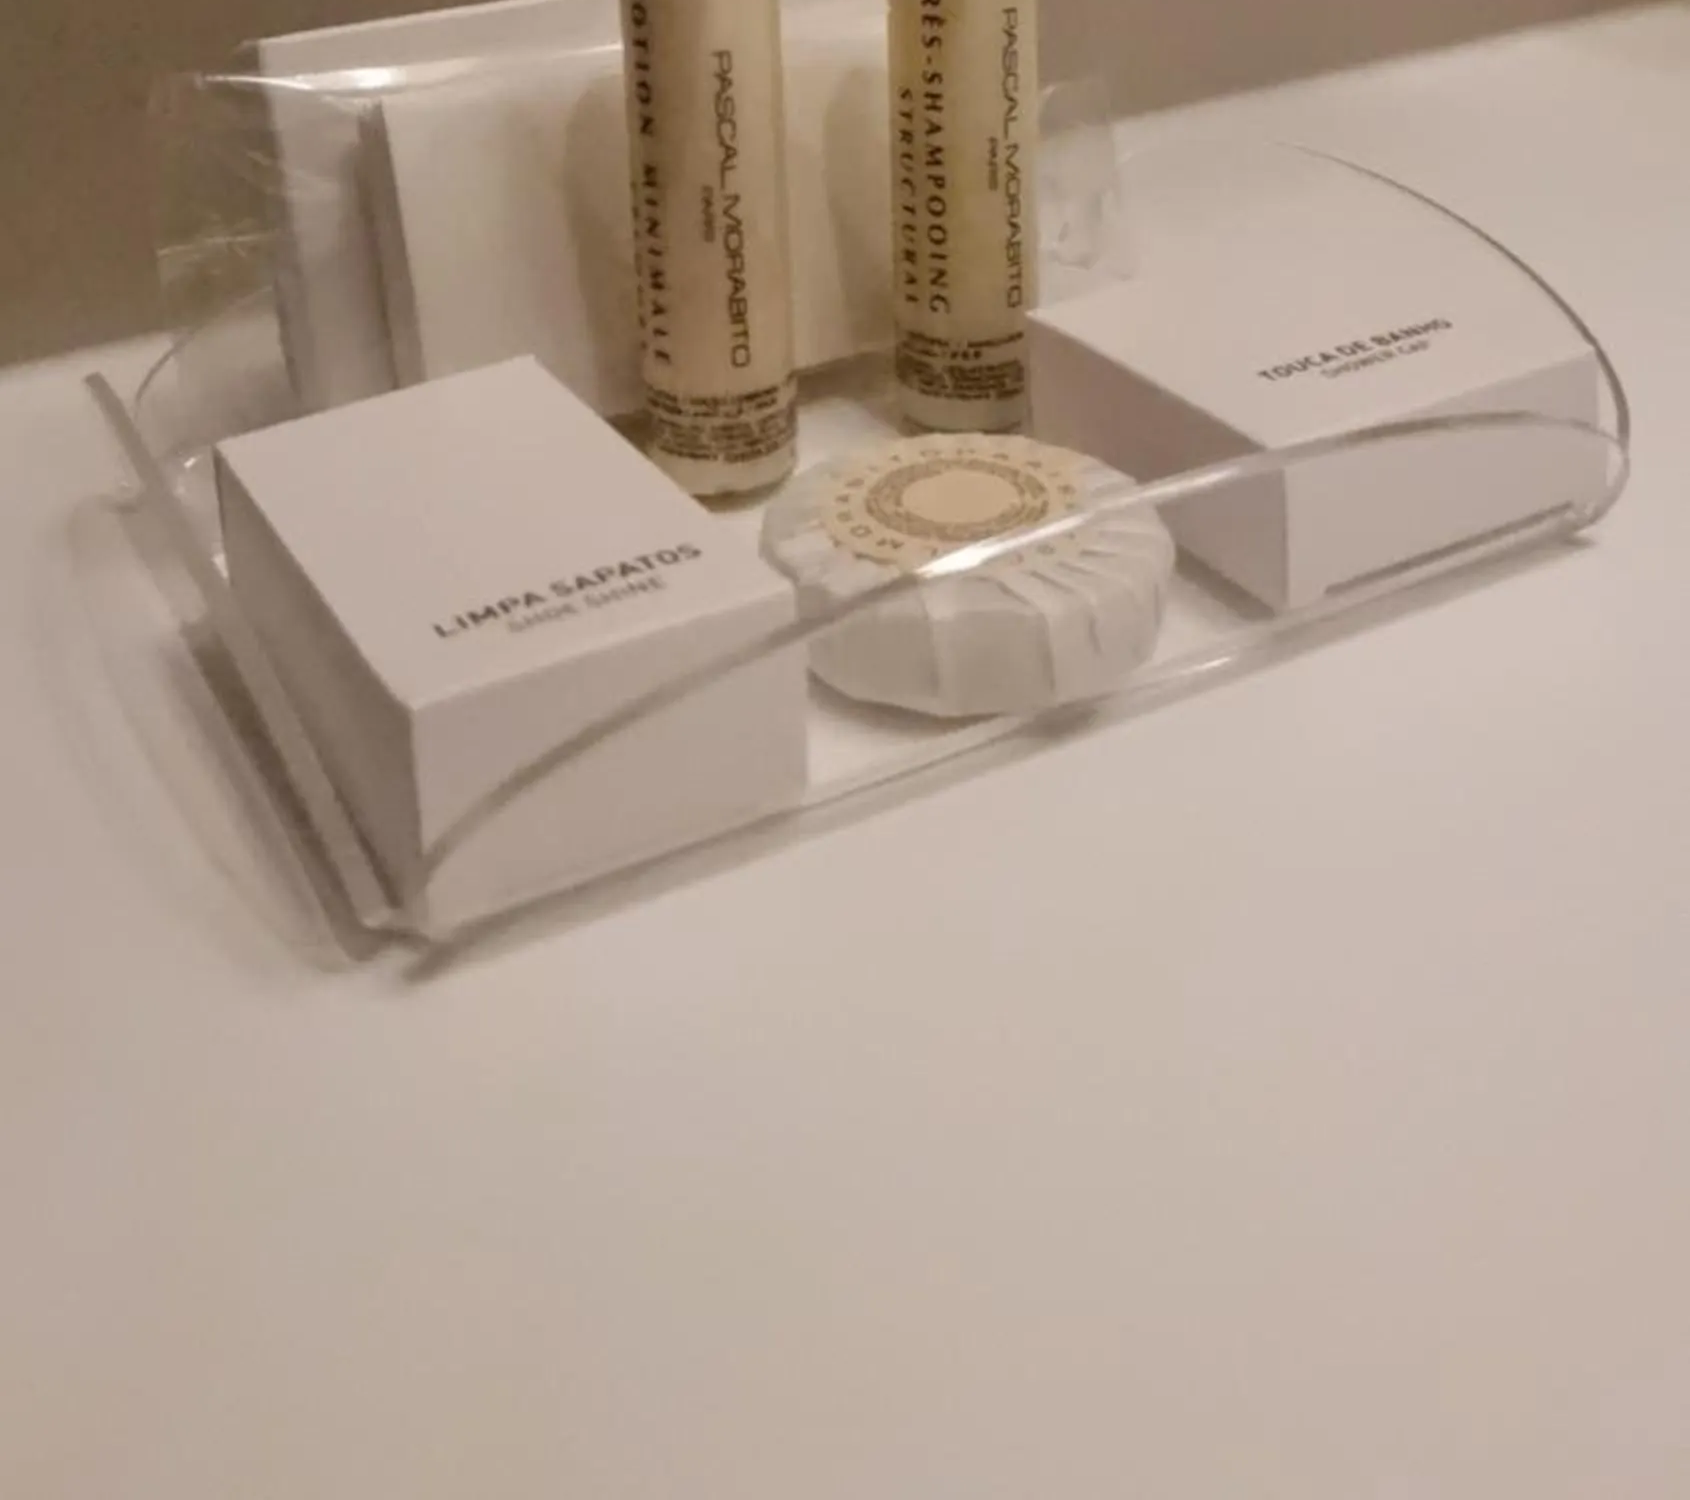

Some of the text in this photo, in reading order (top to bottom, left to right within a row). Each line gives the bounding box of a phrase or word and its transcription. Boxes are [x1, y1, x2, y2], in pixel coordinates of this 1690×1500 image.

[710, 51, 751, 368] PASCAL MORABITO
[1001, 7, 1023, 310] PASCAL MORABITO
[1256, 317, 1454, 381] TOUCA DE BANHO
[431, 542, 704, 640] LIMPA SAPATOS
